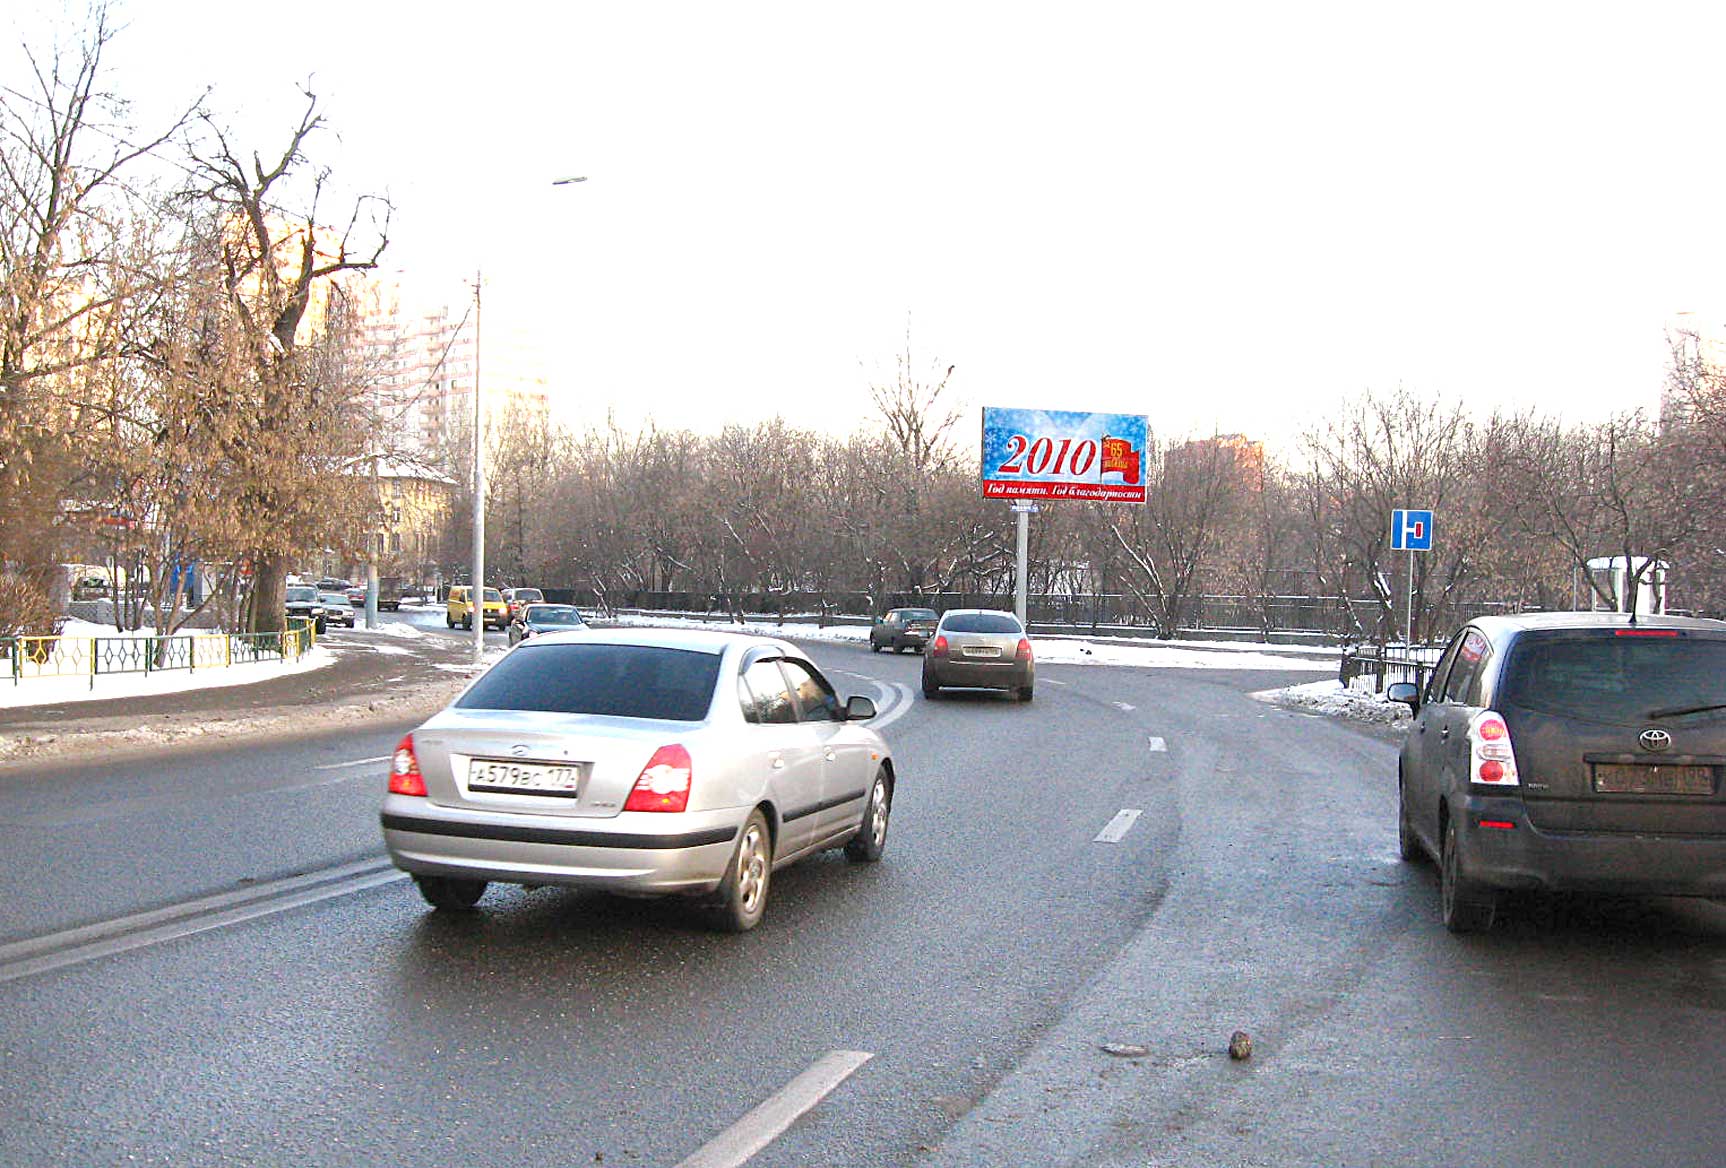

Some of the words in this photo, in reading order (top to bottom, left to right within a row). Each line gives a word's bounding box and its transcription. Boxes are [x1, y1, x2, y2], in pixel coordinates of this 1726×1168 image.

[997, 435, 1097, 476] 2010
[1110, 442, 1123, 457] 65
[987, 483, 1005, 494] Год
[1051, 485, 1067, 495] Год
[1068, 486, 1142, 500] благодарности
